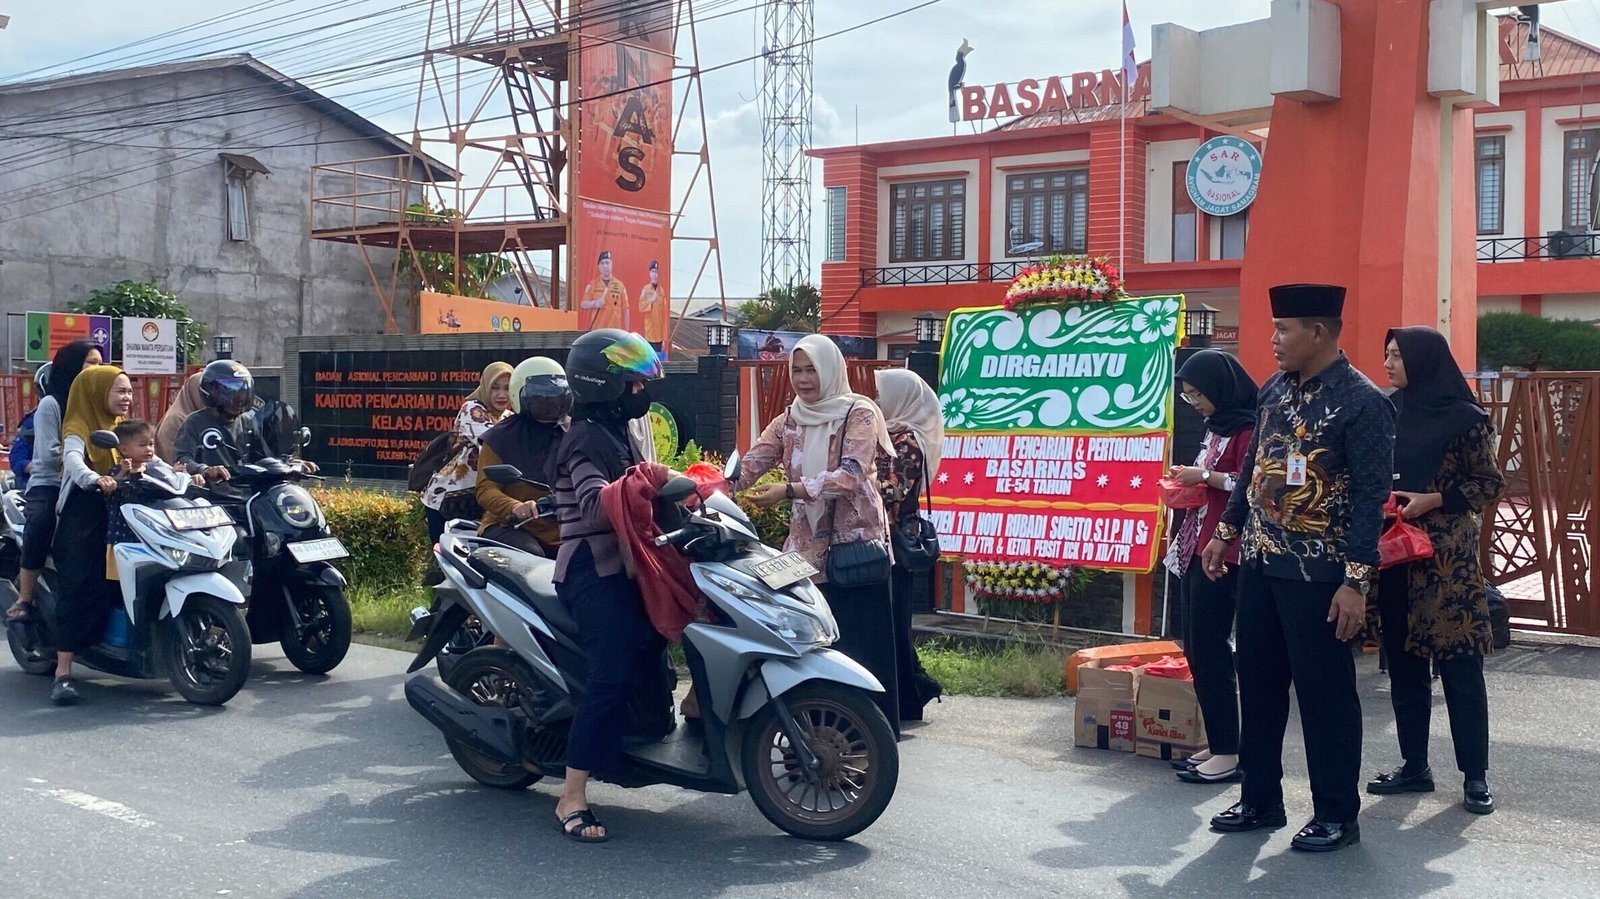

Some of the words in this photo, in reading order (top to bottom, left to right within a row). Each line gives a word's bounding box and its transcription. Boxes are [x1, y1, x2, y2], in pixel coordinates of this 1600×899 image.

[1210, 150, 1240, 162] SAR
[1206, 188, 1241, 202] NASIONAL
[1205, 203, 1230, 213] JAGAT
[1215, 332, 1237, 340] JAGAT
[980, 353, 1127, 378] DIRGAHAYU
[315, 371, 342, 382] BADAN
[382, 371, 429, 382] PENCARIAN
[314, 394, 362, 408] KANTOR
[365, 394, 435, 409] PENCARIAN
[372, 415, 412, 430] KELAS
[414, 416, 424, 431] A
[942, 436, 962, 458] DAN
[962, 436, 1010, 459] NASIONAL
[1012, 436, 1074, 460] PENCARIAN
[1075, 437, 1084, 461] &
[1087, 436, 1165, 461] PERTOLONGAN
[985, 459, 1087, 480] BASARNAS
[996, 478, 1030, 494] KE-54
[1033, 479, 1072, 496] TAHUN
[976, 511, 1004, 537] NOVI
[1005, 513, 1048, 539] RUBADI
[996, 537, 1004, 555] &
[1006, 537, 1031, 556] KETUA
[1033, 539, 1061, 559] PERSIT
[1115, 721, 1129, 730] 48
